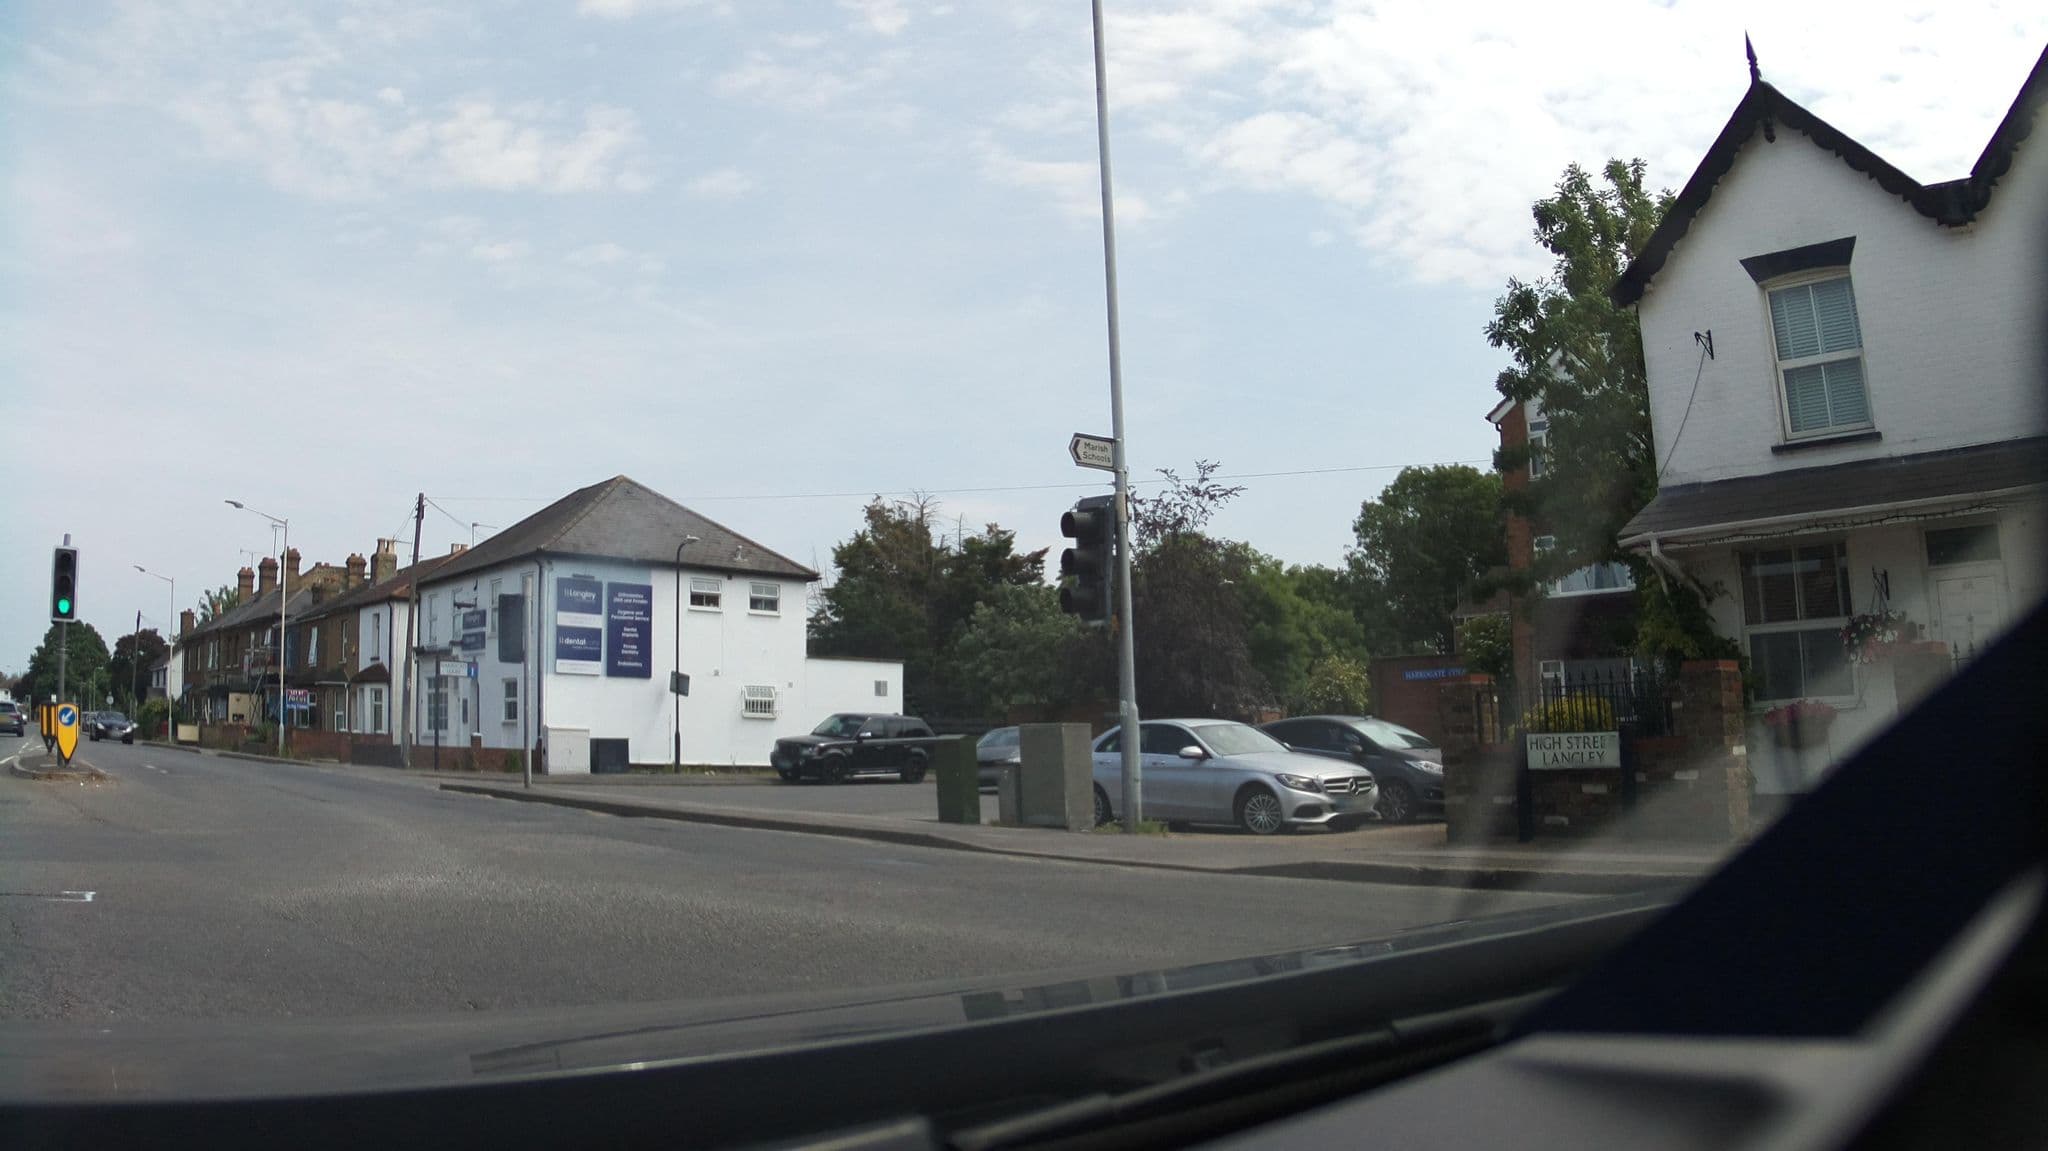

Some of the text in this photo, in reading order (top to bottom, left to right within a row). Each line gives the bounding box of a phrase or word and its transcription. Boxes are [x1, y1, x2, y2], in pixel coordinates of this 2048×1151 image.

[1084, 442, 1108, 452] Marish
[1082, 451, 1111, 463] Schools
[1529, 736, 1561, 750] HIGH
